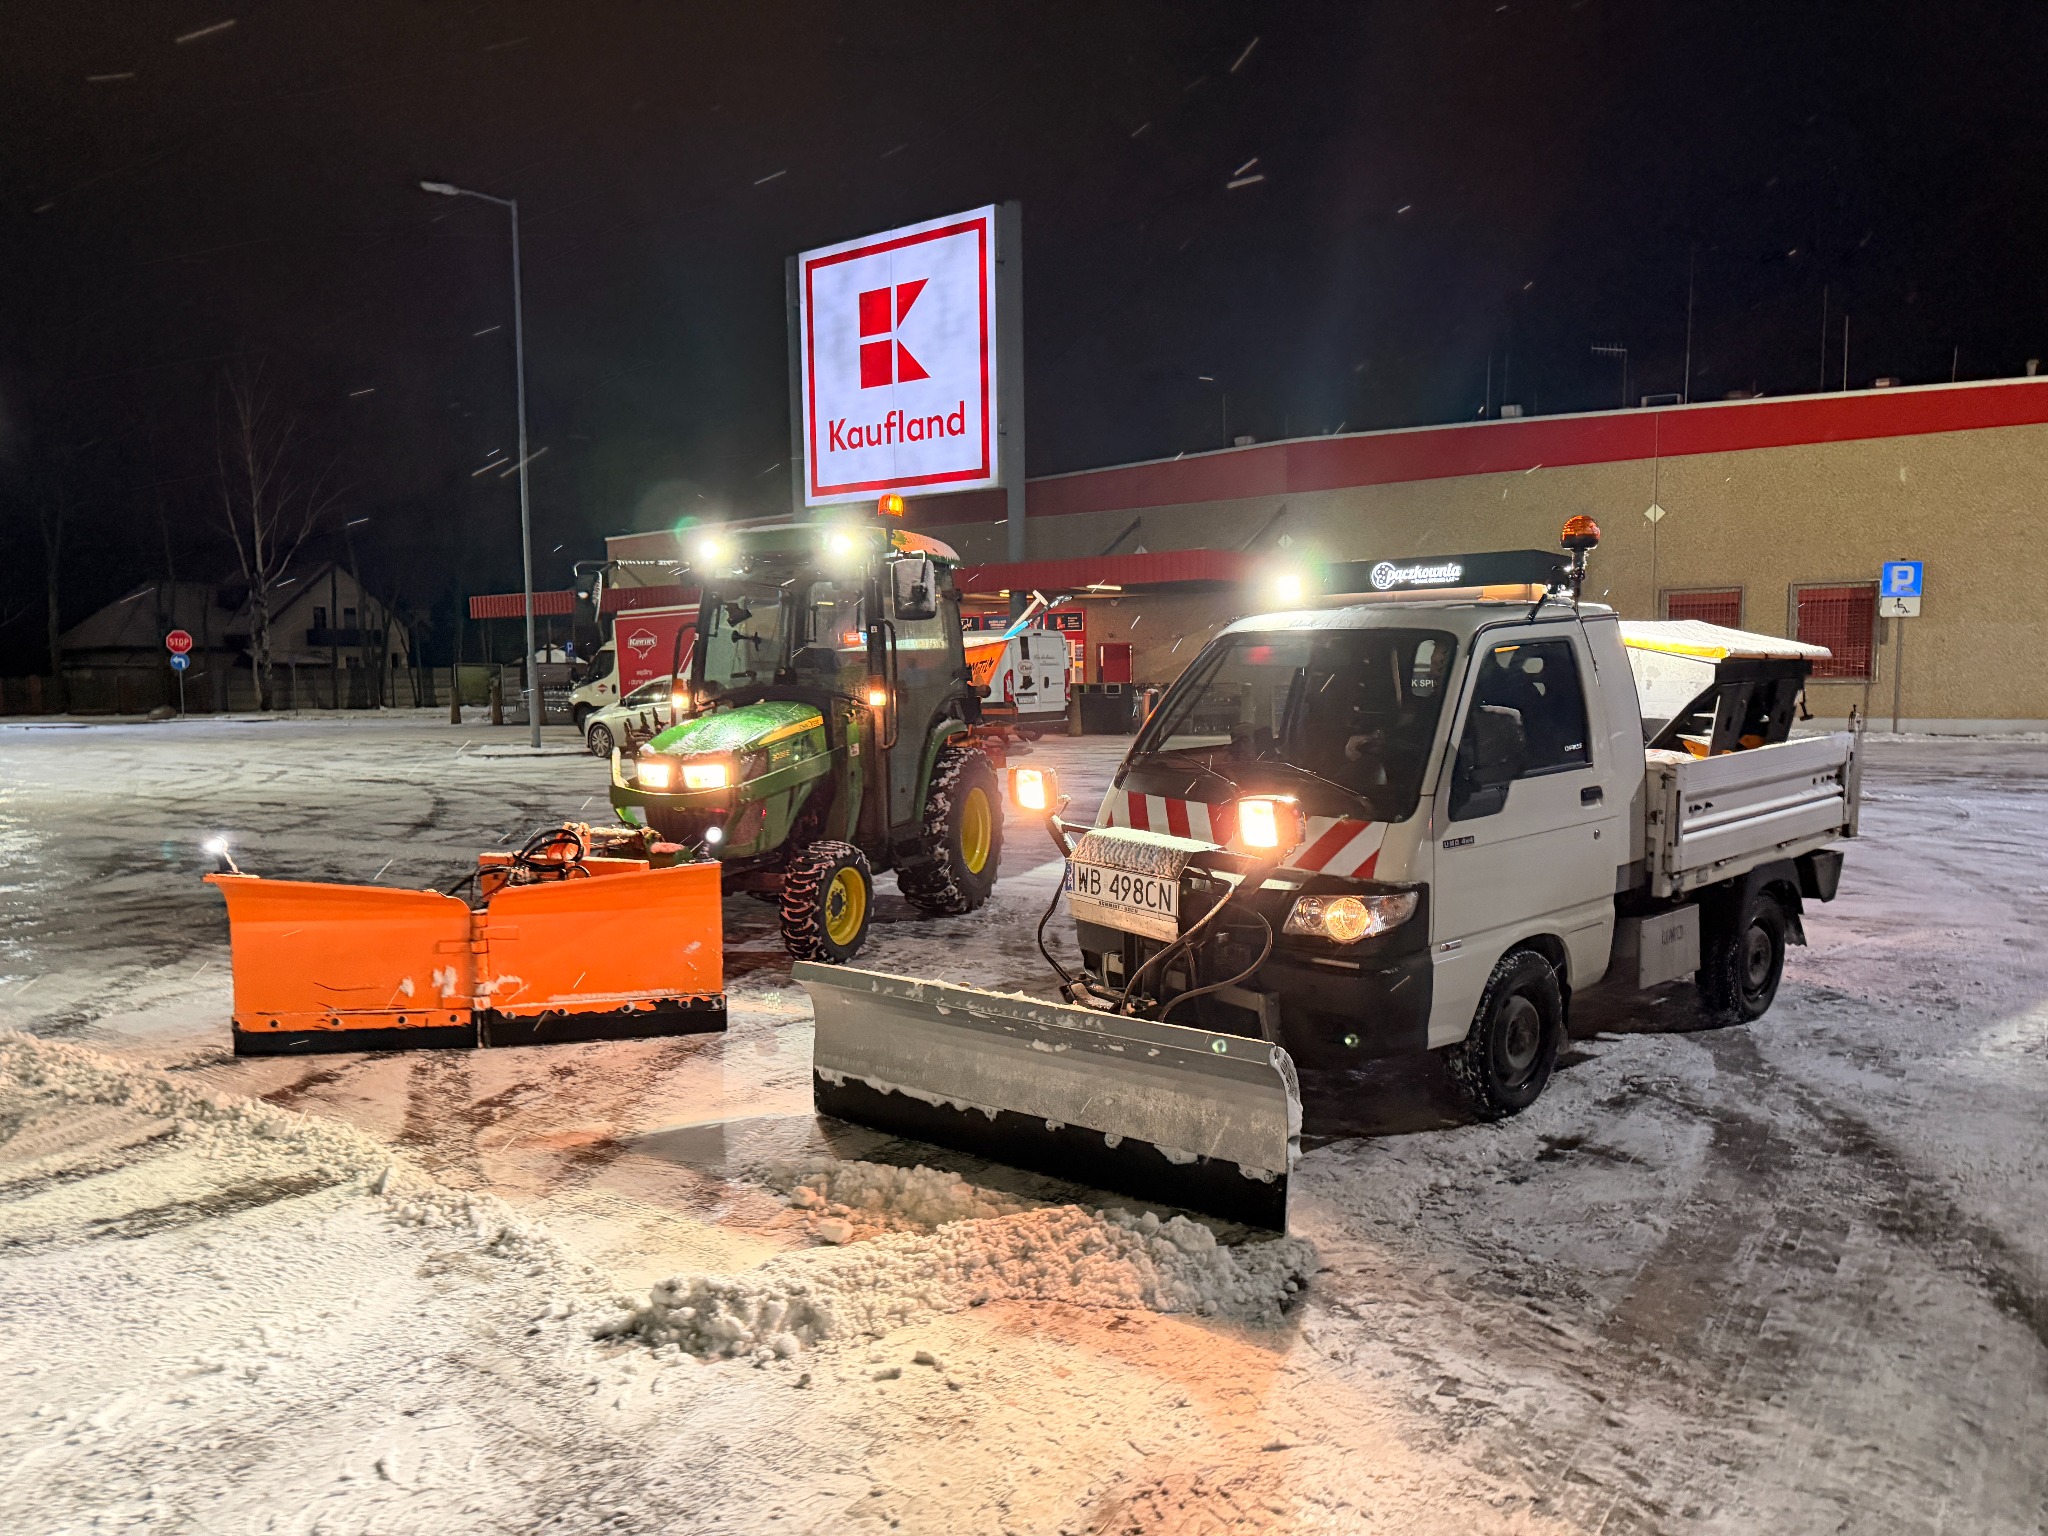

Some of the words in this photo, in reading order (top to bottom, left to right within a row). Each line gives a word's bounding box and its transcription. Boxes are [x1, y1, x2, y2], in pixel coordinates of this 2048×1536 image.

[829, 400, 966, 453] Kaufland
[1891, 565, 1915, 593] P
[169, 638, 189, 646] STOP
[1078, 867, 1101, 895] WB
[1109, 874, 1171, 912] 498CN
